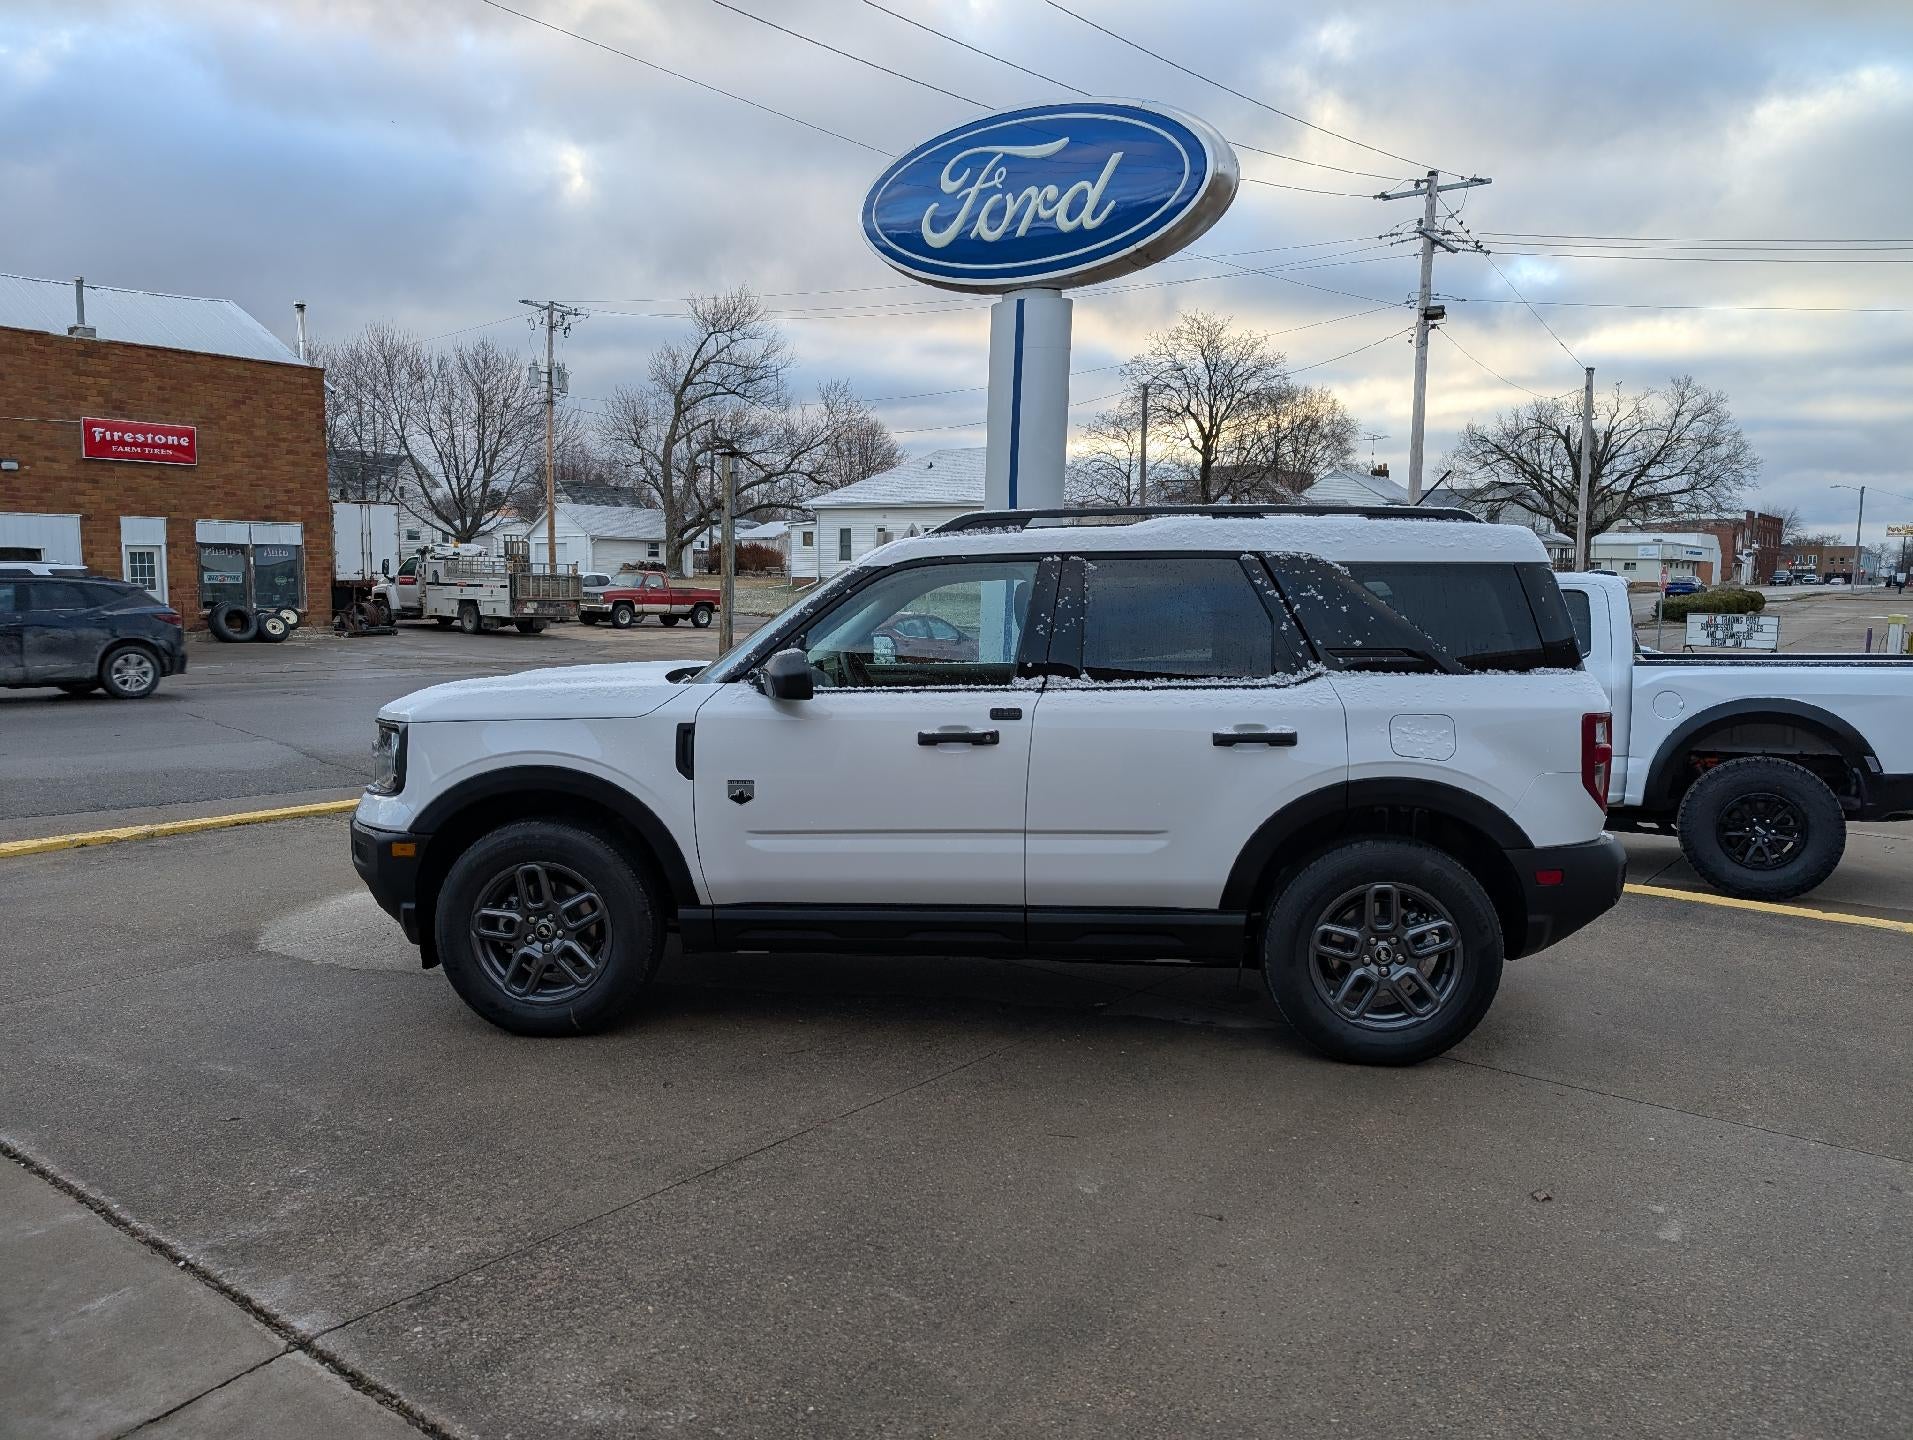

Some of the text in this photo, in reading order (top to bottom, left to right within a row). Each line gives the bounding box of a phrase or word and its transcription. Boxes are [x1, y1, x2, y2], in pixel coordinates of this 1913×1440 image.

[921, 136, 1123, 249] Ford
[91, 427, 190, 446] Firestone
[112, 445, 173, 455] FARM TIRES
[1706, 631, 1753, 640] AND TRANSFERS
[1711, 639, 1726, 647] BEGIN
